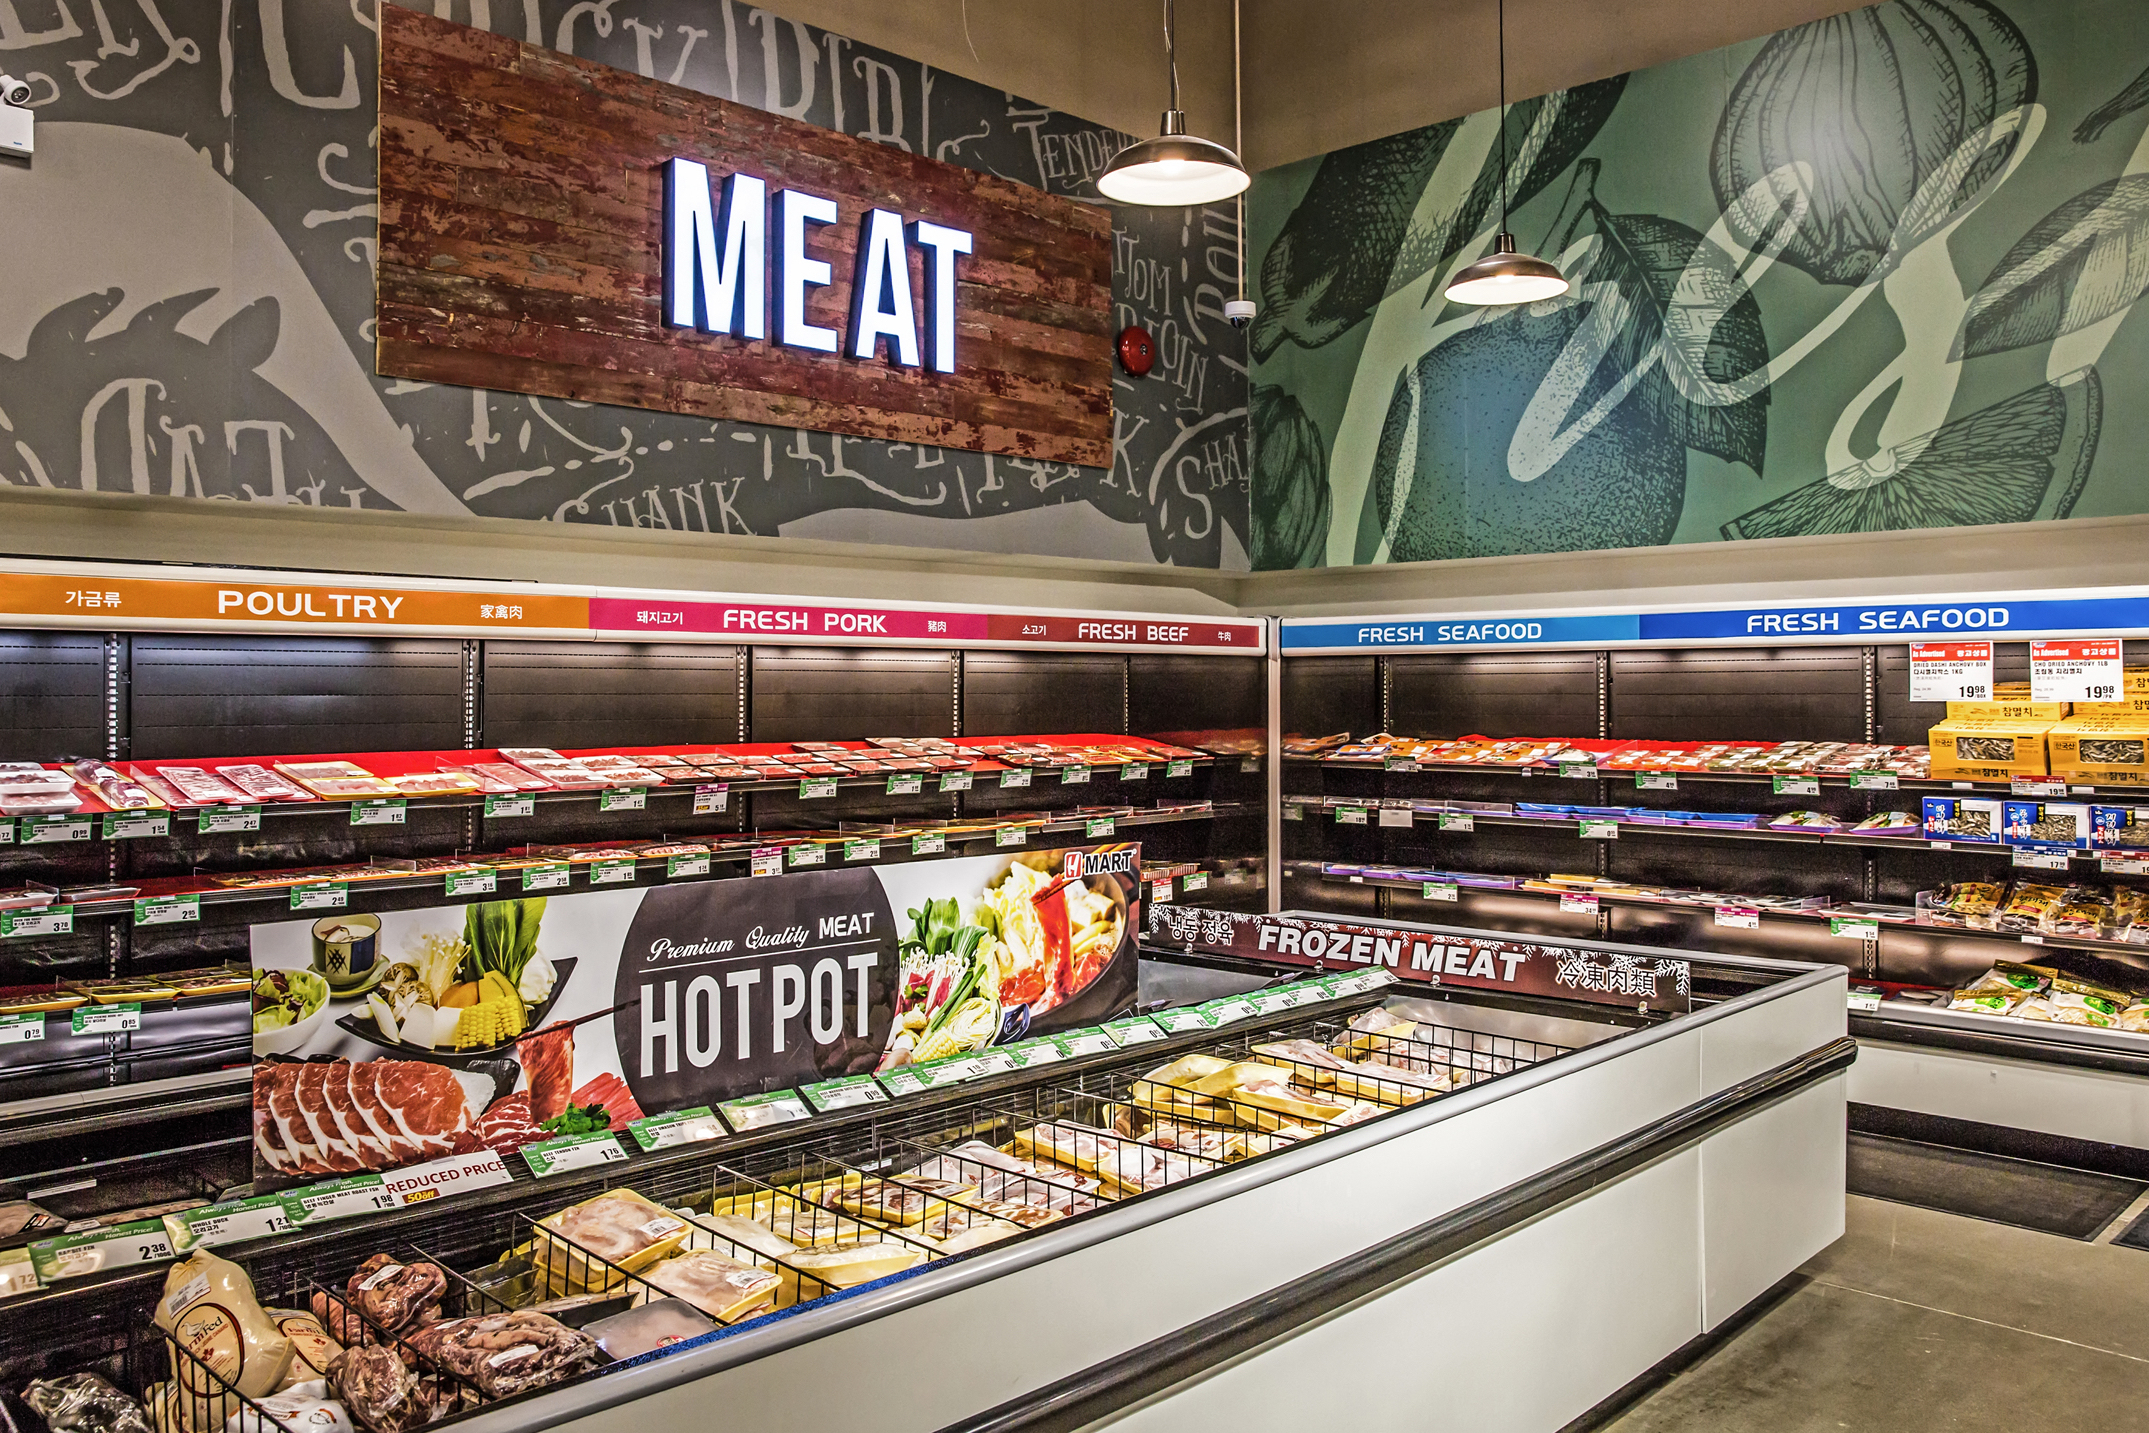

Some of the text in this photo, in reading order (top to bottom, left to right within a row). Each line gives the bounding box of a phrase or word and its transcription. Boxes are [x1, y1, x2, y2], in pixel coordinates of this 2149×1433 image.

[665, 156, 973, 374] MEAT
[65, 590, 122, 608] 가금류
[217, 590, 404, 620] POULTRY
[480, 603, 523, 621] 家禽肉
[636, 610, 683, 626] 돼지고기
[723, 609, 888, 634] FRESH PORK
[1746, 606, 2009, 634] FRESH SEAFOOD
[927, 620, 947, 633] 豬肉
[1021, 623, 1047, 636] 소고기
[1078, 622, 1189, 642] FRESH BEEF
[1217, 630, 1231, 642] 牛肉
[1357, 623, 1543, 643] FRESH SEAFOOD
[2001, 706, 2033, 718] 참멸치
[1981, 768, 2009, 779] 참멸치
[1085, 851, 1133, 874] MART
[647, 912, 875, 962] Premium Quality MEAT
[1168, 915, 1234, 946] 냉동 정육
[1258, 924, 1527, 982] FROZEN MEAT
[1555, 959, 1658, 998] 冷凍肉類
[385, 1160, 507, 1195] REDUCED PRICE
[190, 1219, 213, 1229] WHOLE
